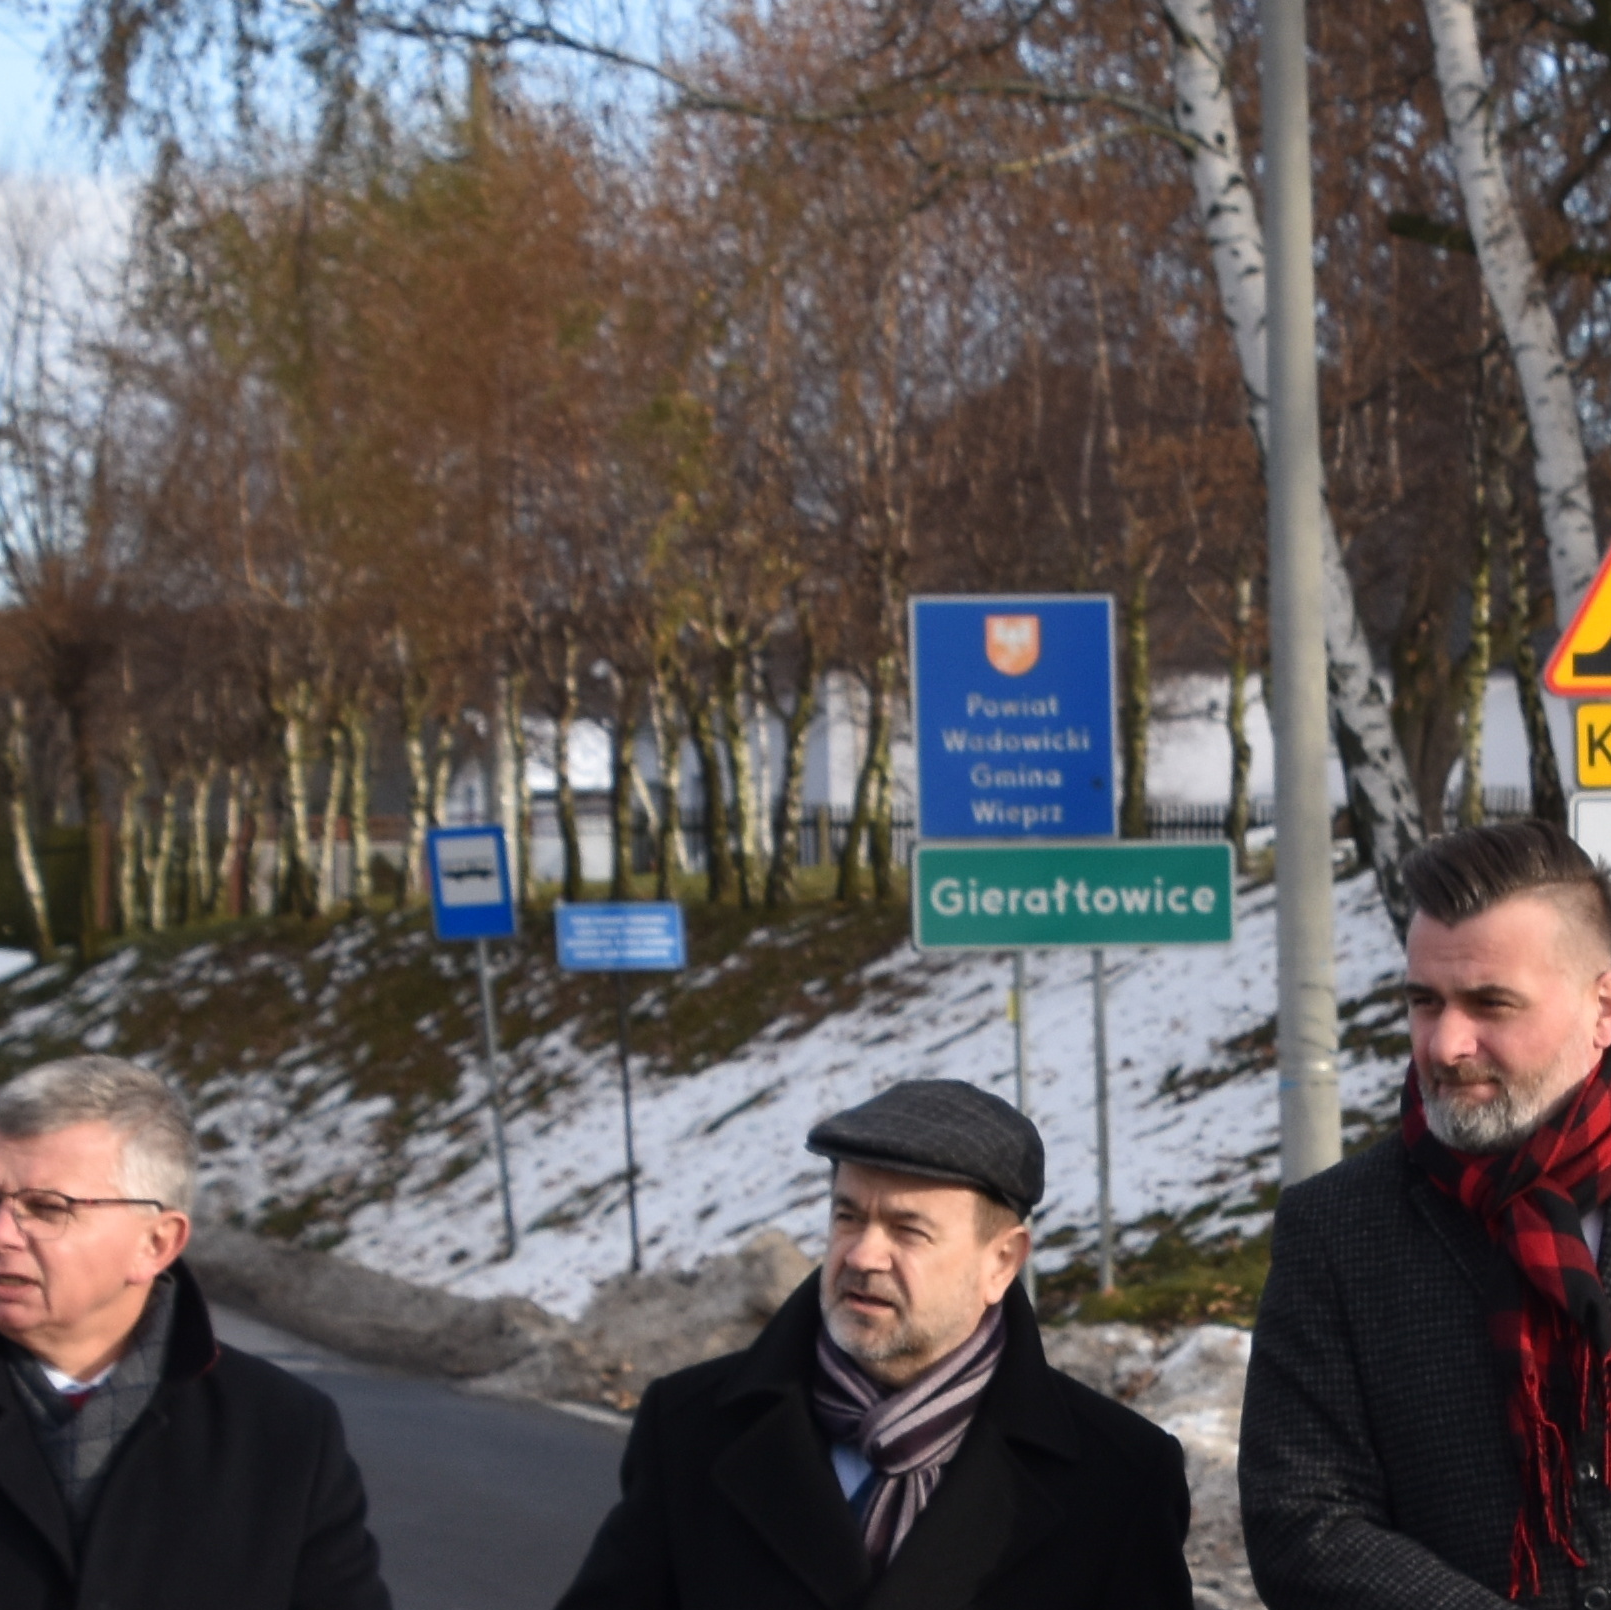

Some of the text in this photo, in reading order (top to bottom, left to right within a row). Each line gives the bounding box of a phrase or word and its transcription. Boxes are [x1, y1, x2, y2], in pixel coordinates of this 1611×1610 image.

[966, 691, 1060, 718] Powiat
[942, 726, 1091, 752] Wadowicki
[969, 763, 1063, 788] Gmina
[971, 800, 1063, 830] Wieprz
[930, 876, 1217, 916] Gierałtowice
